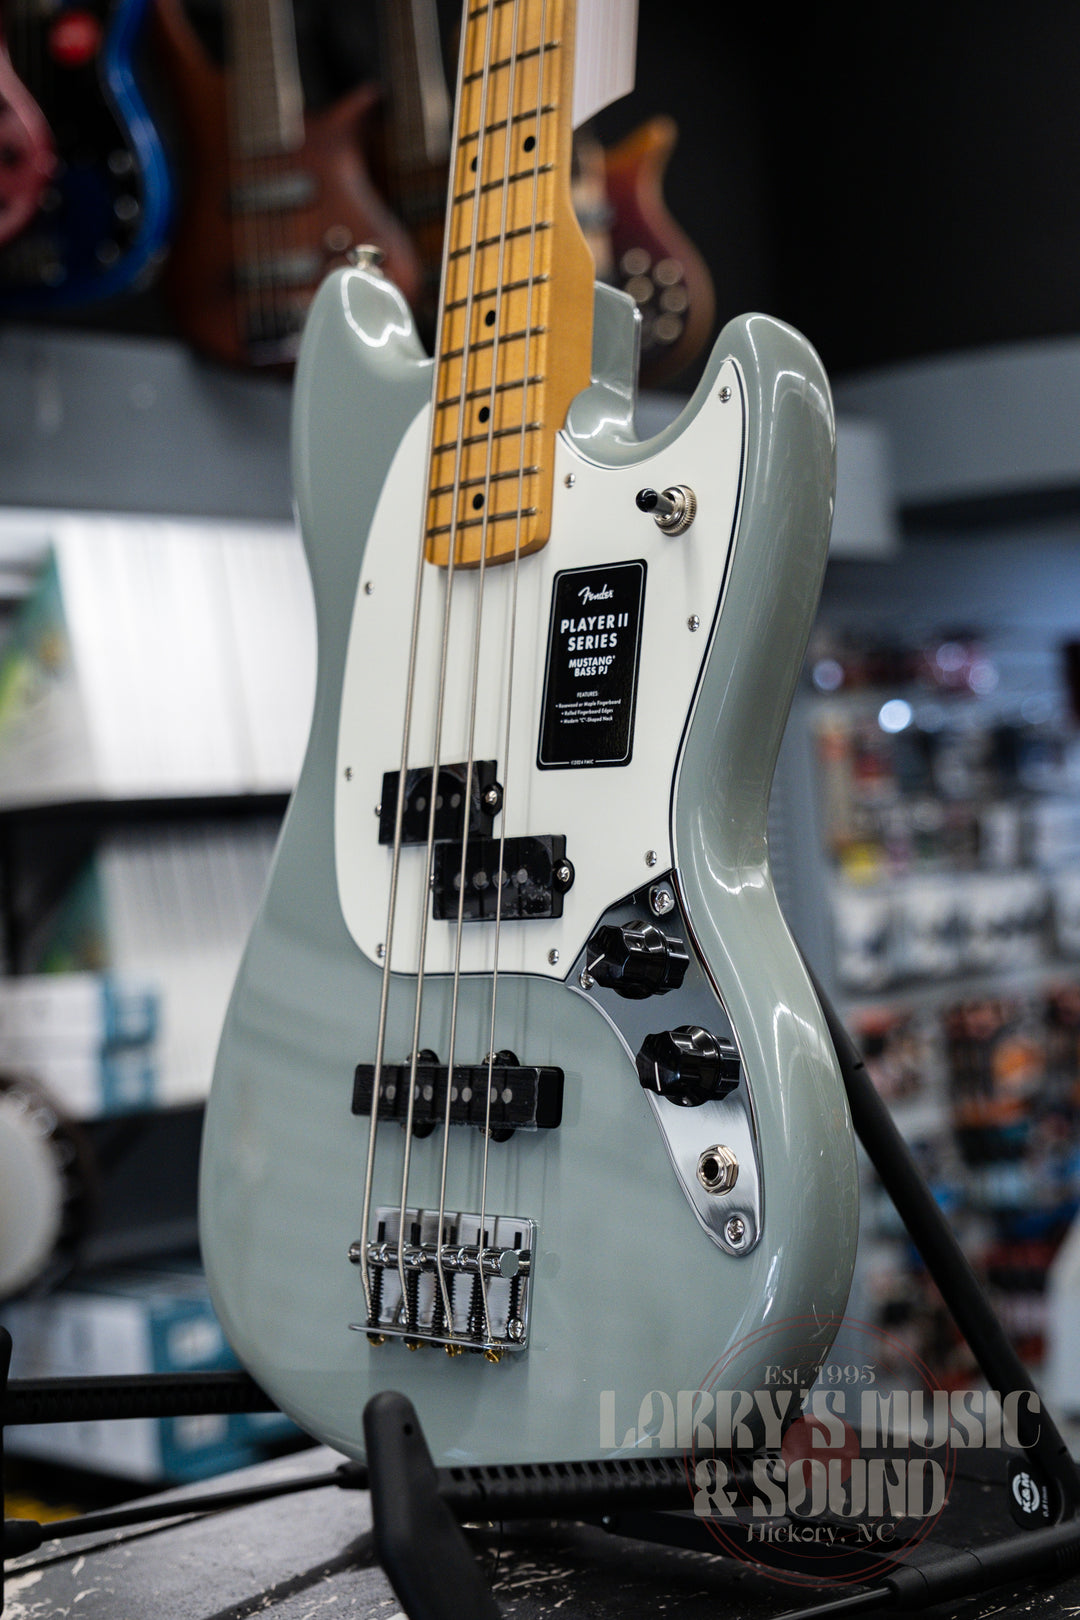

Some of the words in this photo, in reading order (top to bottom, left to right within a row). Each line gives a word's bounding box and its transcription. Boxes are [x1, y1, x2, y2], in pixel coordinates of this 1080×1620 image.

[578, 584, 614, 605] Fender
[561, 615, 615, 634] PLAYER
[618, 613, 628, 627] II
[568, 633, 617, 652] SERIES
[574, 667, 596, 677] BASS
[598, 666, 608, 675] PJ
[578, 708, 601, 716] Fingerboard
